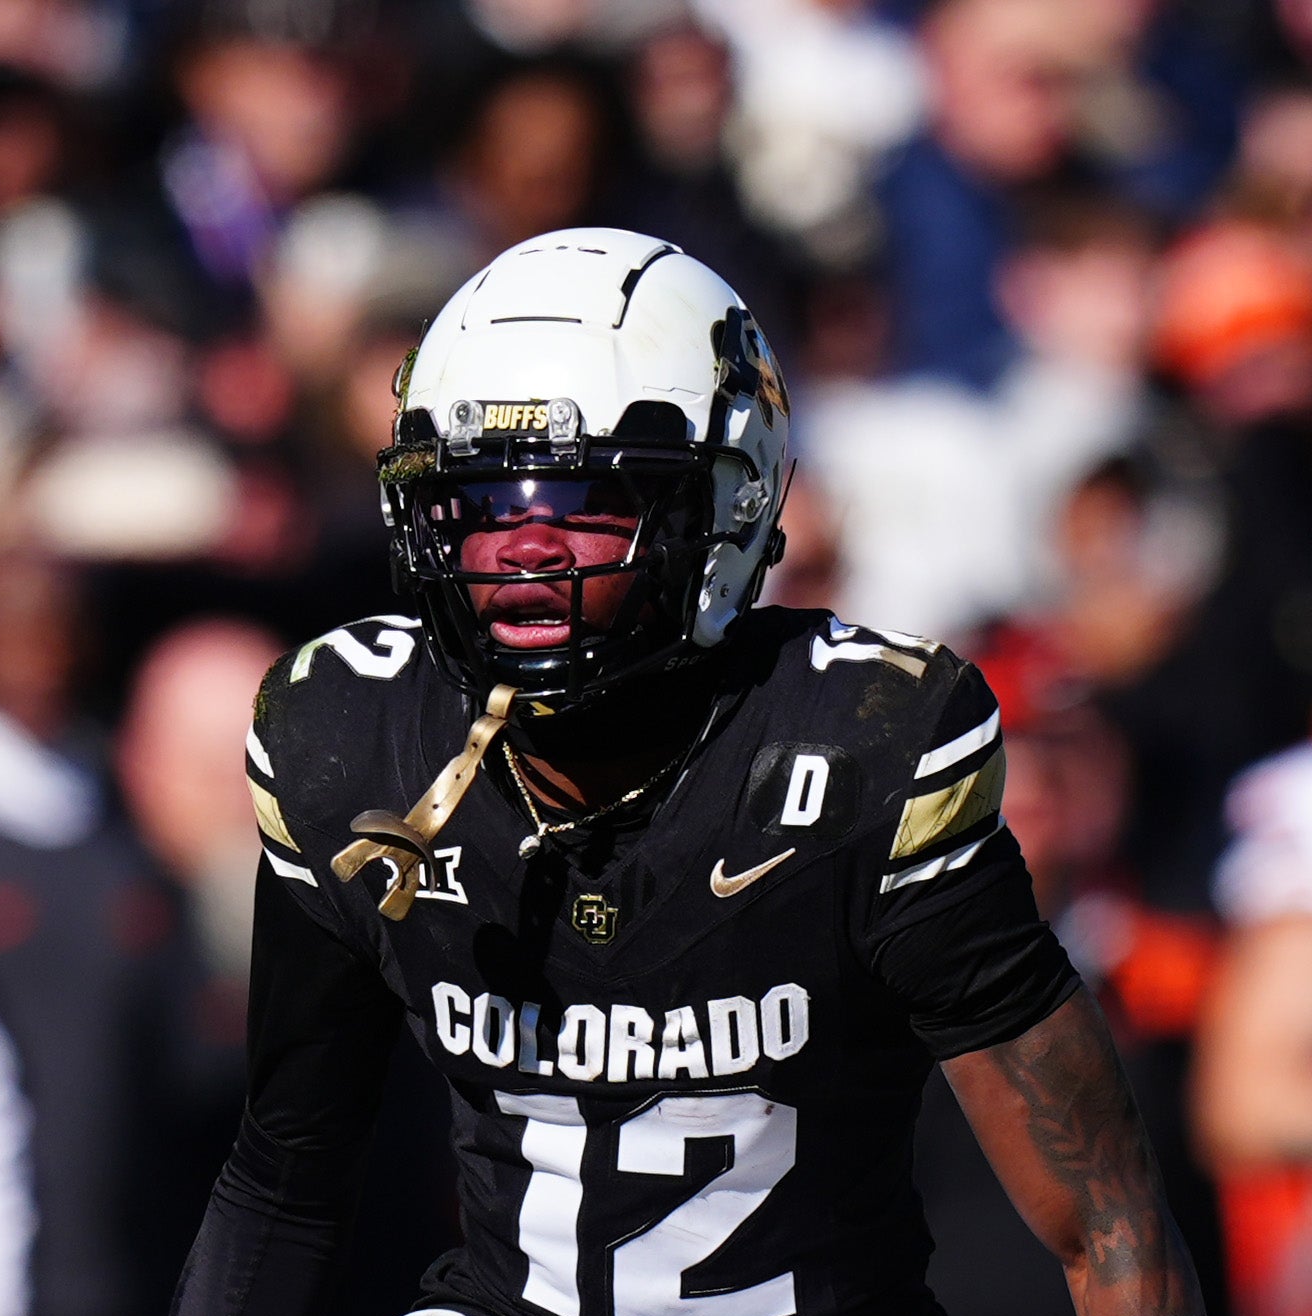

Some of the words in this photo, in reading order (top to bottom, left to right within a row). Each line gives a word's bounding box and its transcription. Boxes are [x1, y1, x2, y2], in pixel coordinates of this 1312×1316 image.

[483, 404, 549, 431] BUFFS
[779, 754, 831, 827] D
[431, 981, 811, 1082] COLORADO
